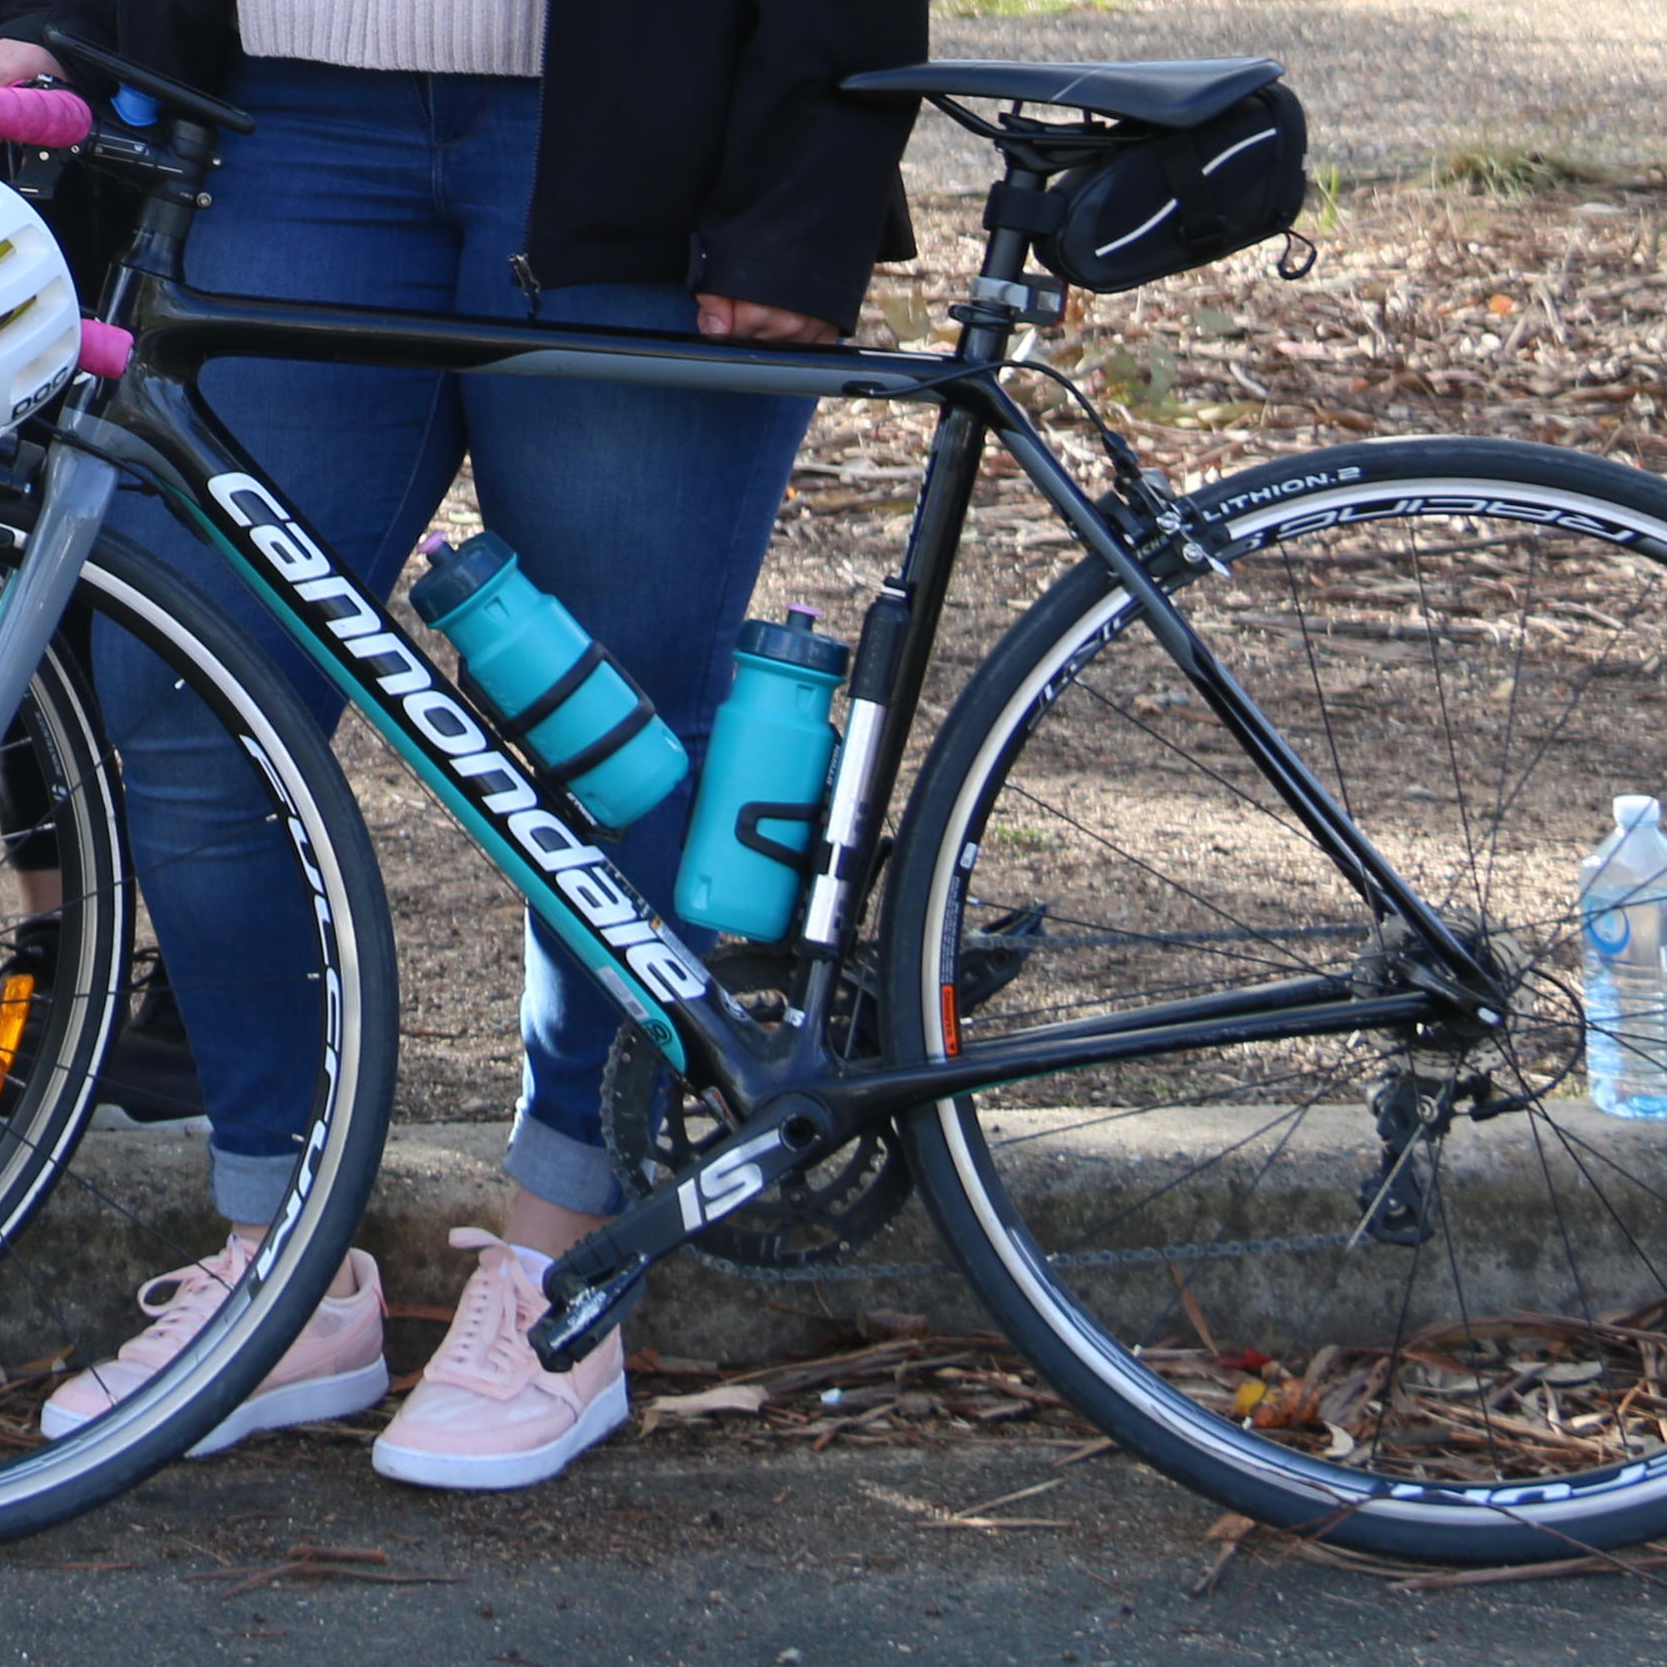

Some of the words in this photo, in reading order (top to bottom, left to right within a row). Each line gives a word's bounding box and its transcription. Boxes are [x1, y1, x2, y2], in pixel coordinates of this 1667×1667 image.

[207, 472, 707, 1002] cannondale
[1201, 466, 1361, 523] LITHION.2
[239, 733, 341, 1282] FULCRUM
